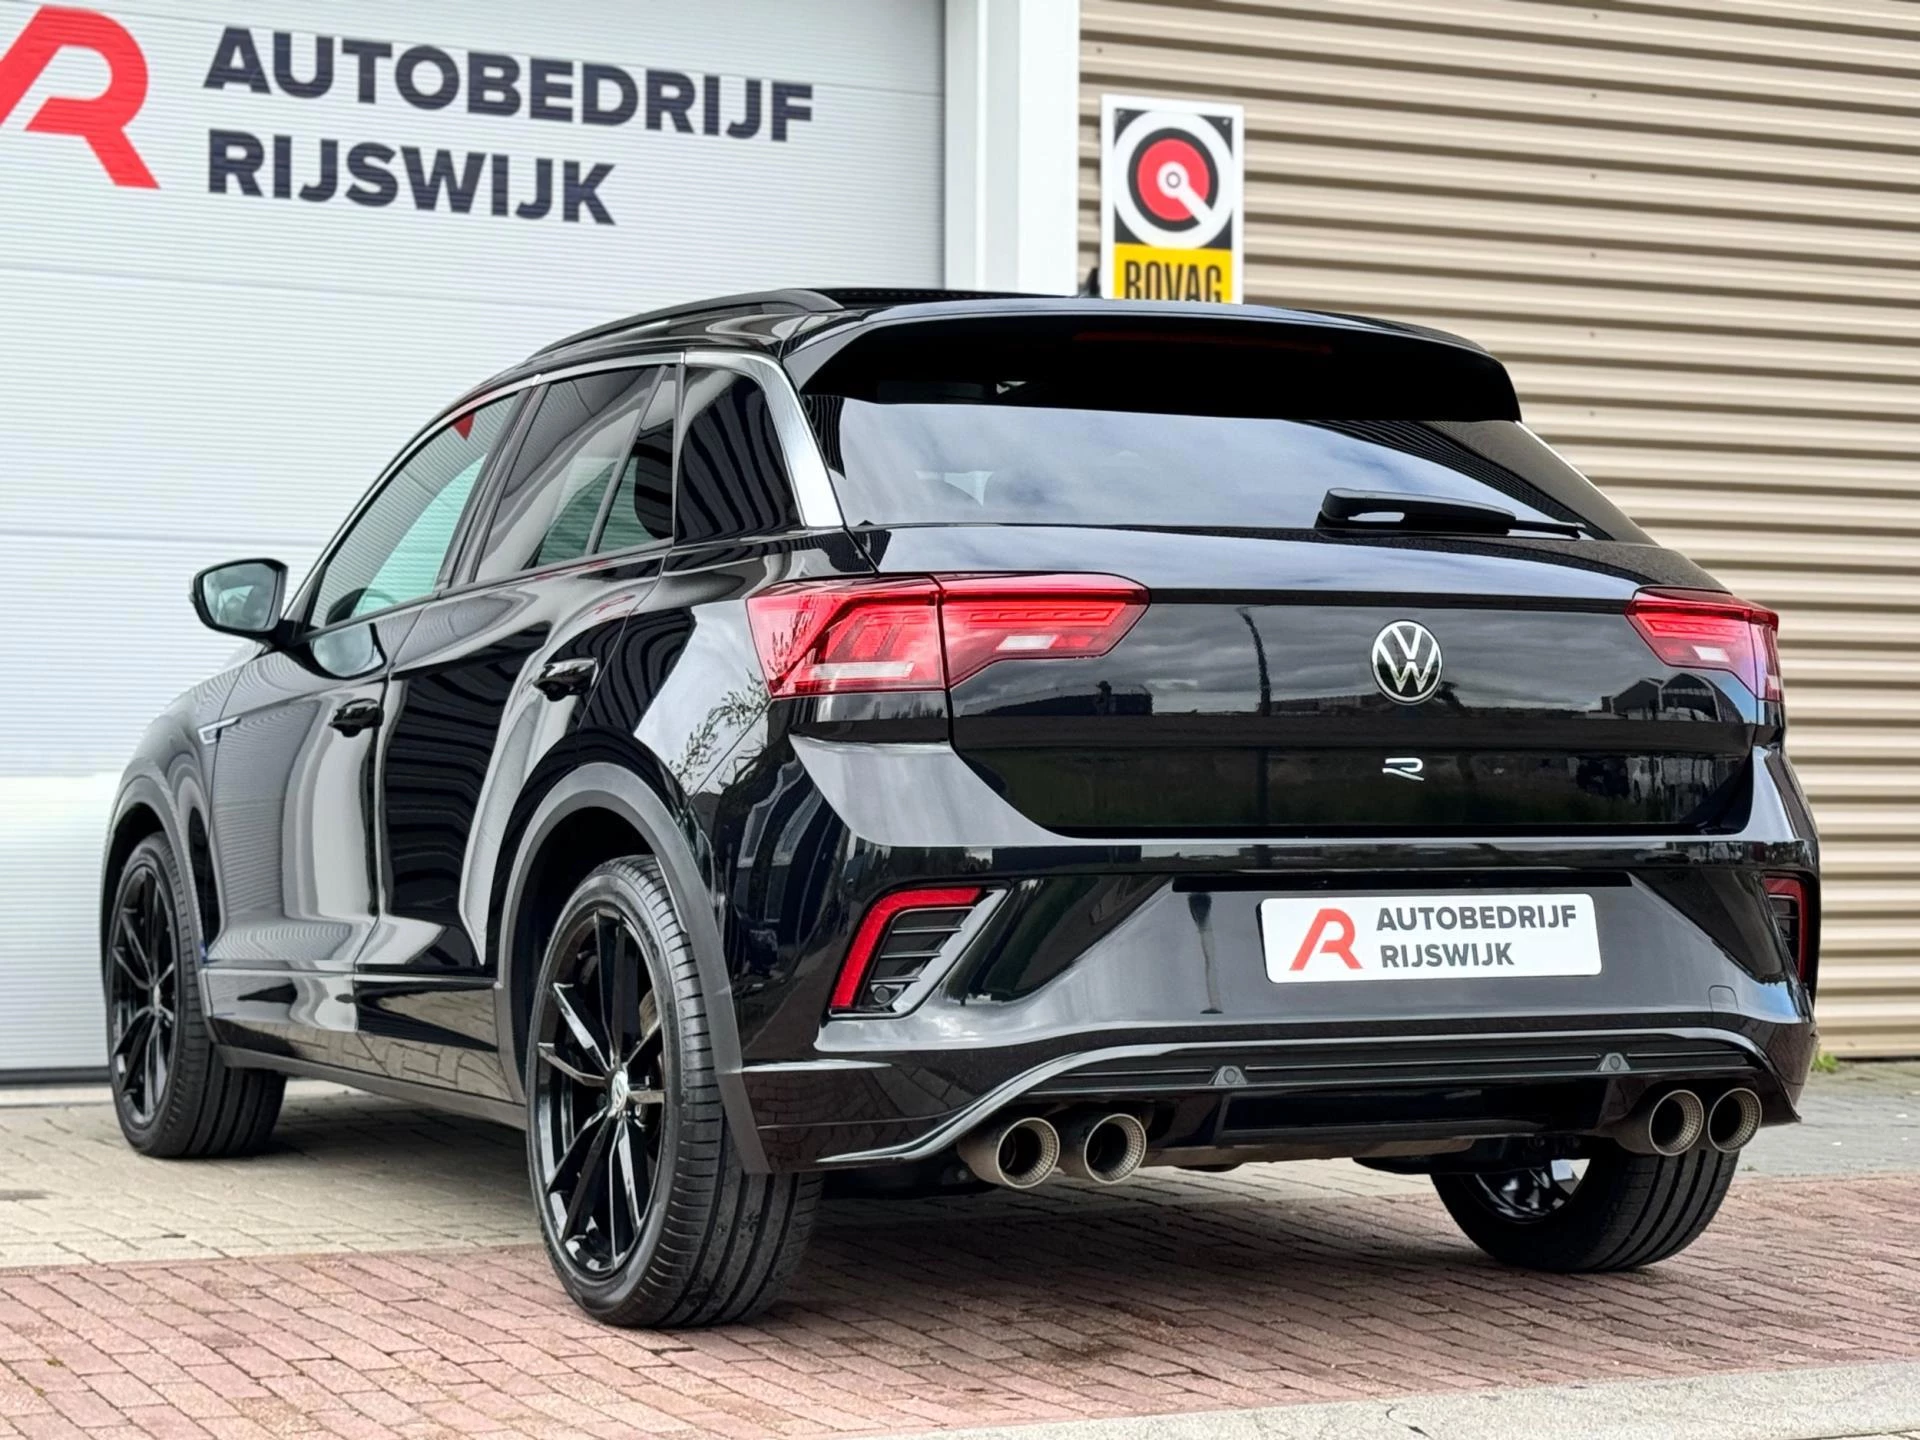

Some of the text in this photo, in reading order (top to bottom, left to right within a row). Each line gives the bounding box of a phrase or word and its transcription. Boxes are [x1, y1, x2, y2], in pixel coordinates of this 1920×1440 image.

[204, 26, 813, 142] AUTOBEDRIJF
[208, 128, 616, 226] RIJSWIJK
[1124, 259, 1222, 302] BOVAG
[1382, 757, 1424, 781] R
[1376, 904, 1577, 931] AUTOBEDRIJF
[1380, 942, 1515, 968] RIJSWIJK
